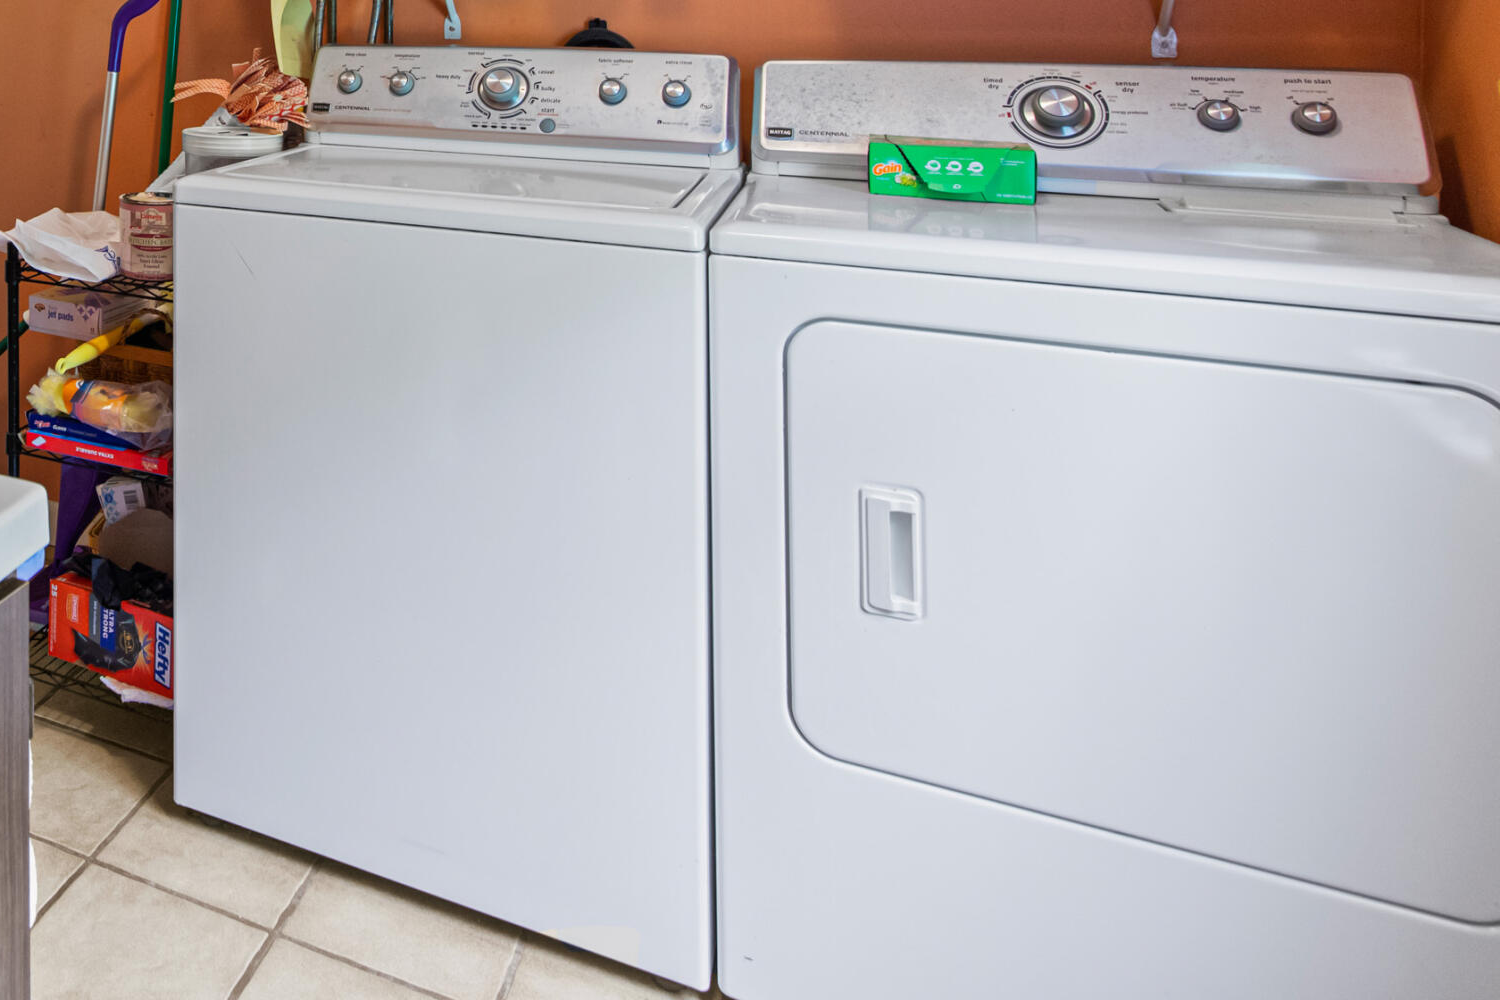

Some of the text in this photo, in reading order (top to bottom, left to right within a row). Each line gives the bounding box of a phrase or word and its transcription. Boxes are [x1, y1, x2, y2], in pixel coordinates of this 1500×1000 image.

[1191, 75, 1236, 83] temperature
[769, 128, 850, 137] MAYTAG CENTENNIAL
[872, 162, 903, 176] Gain
[57, 312, 74, 321] pads
[51, 584, 58, 598] 25
[155, 626, 171, 684] Hefty
